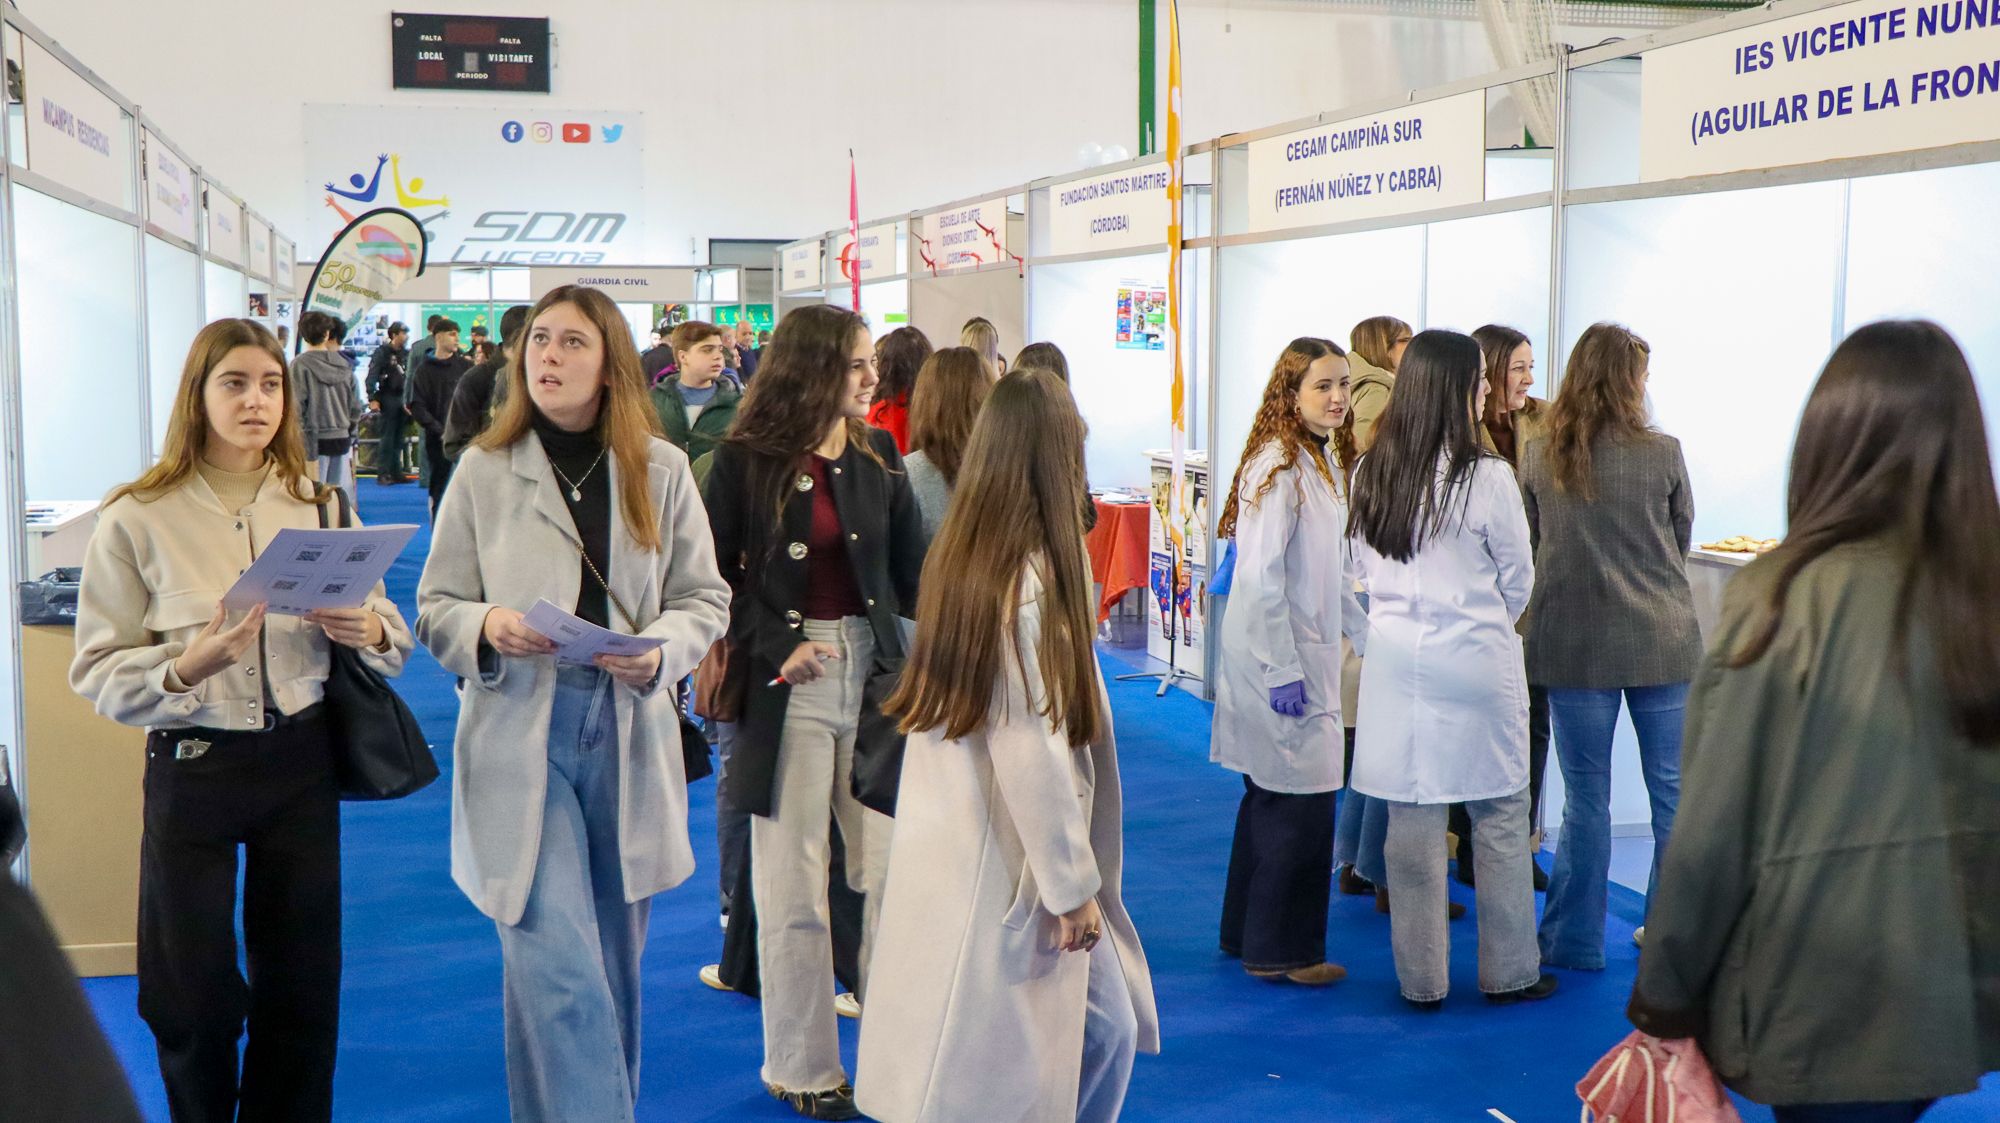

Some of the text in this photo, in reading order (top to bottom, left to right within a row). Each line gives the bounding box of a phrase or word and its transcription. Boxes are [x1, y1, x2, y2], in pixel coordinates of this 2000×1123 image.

[420, 34, 442, 42] FALTA
[1735, 41, 1774, 75] IES
[1783, 8, 1906, 63] VICENTE
[419, 51, 444, 61] LOCAL
[488, 53, 534, 63] VISITANTE
[456, 72, 489, 80] PERIODO
[1691, 94, 1808, 146] (AGUILAR
[1817, 86, 1853, 119] DE
[1863, 78, 1900, 112] LA
[1287, 118, 1422, 162] CEGAM CAMPIÑA SUR
[1100, 177, 1129, 198] SANTOS
[1131, 171, 1167, 193] MÁRTIRE
[1275, 165, 1442, 213] (FERNÁN NÚÑEZ Y CABRA)
[463, 211, 627, 243] SDM
[451, 245, 607, 264] Lucena
[577, 277, 649, 286] GUARDIA CIVIL
